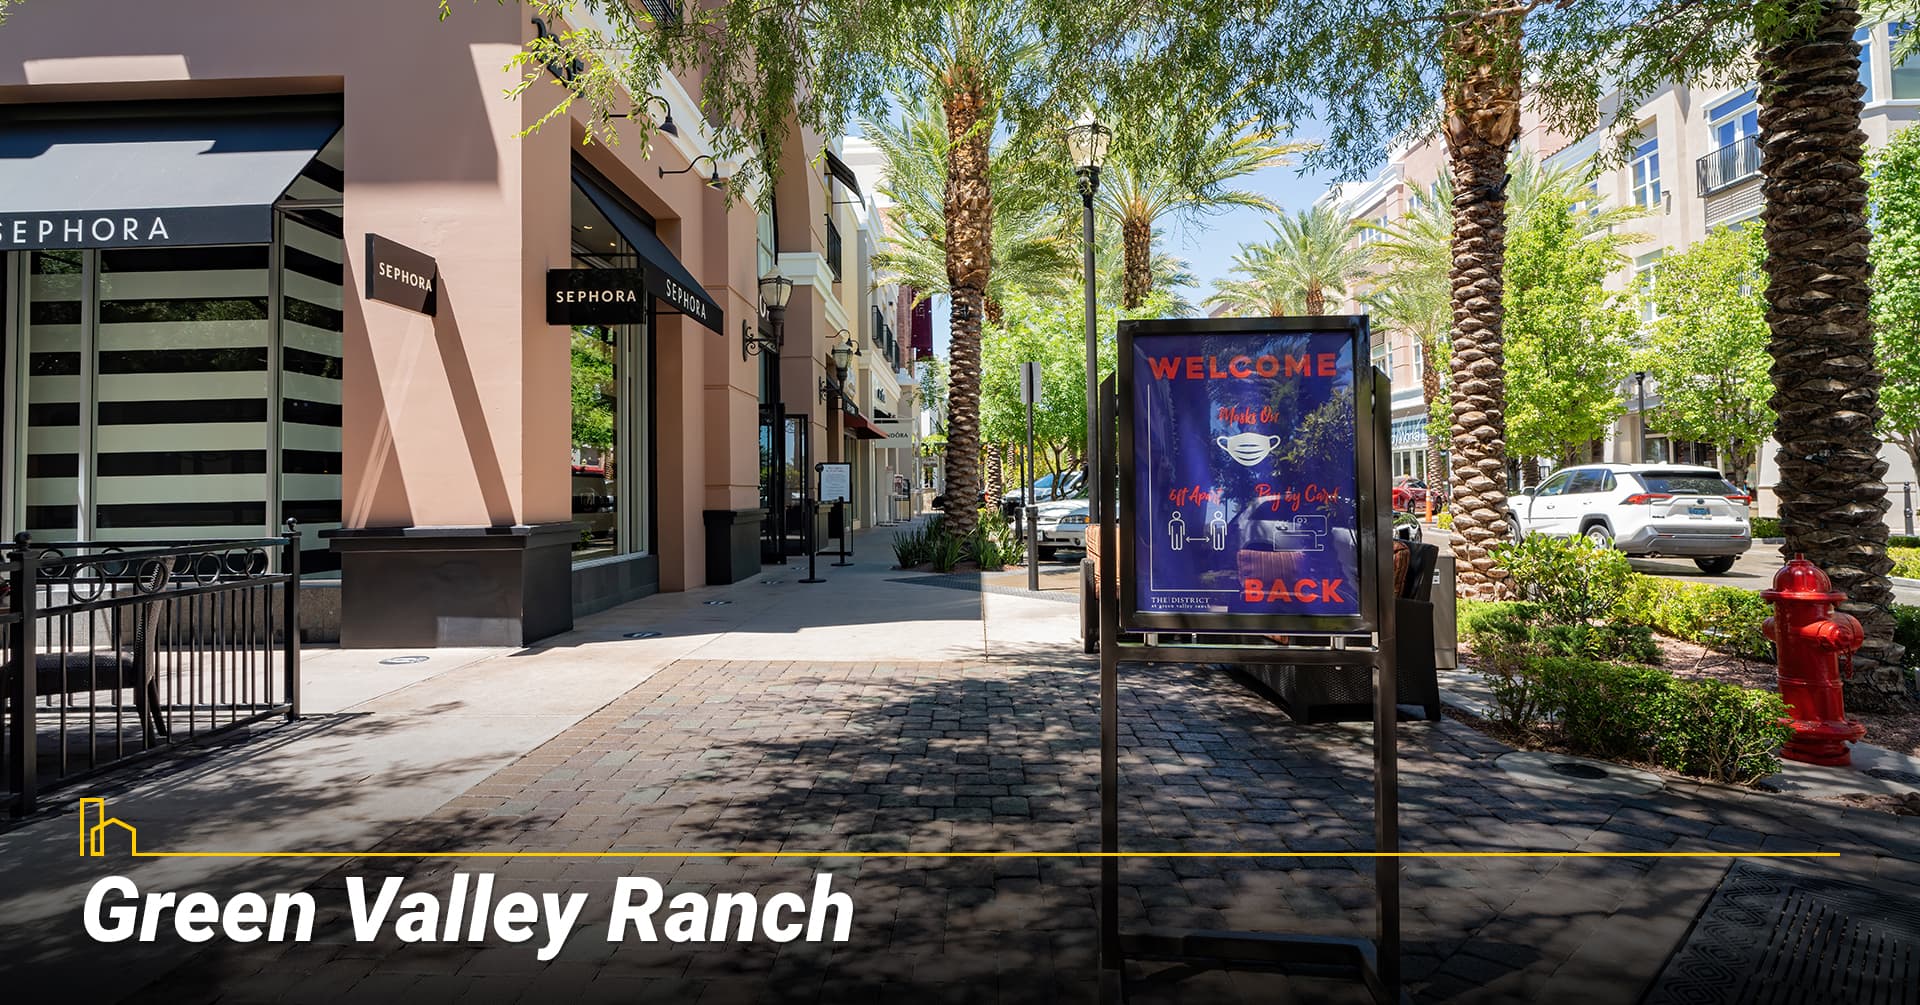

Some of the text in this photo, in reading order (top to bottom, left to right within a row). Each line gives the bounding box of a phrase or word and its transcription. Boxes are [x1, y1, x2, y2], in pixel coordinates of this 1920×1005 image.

[0, 217, 169, 243] EPHORA
[379, 262, 432, 292] SEPHORA
[556, 290, 637, 303] SEPHORA
[665, 279, 707, 320] SEPHORA
[1148, 353, 1337, 380] WELCOME
[1218, 404, 1280, 427] Masks On
[1168, 485, 1224, 507] 6ft Apart
[1254, 483, 1341, 512] Pay by Card
[1244, 578, 1345, 603] BACK
